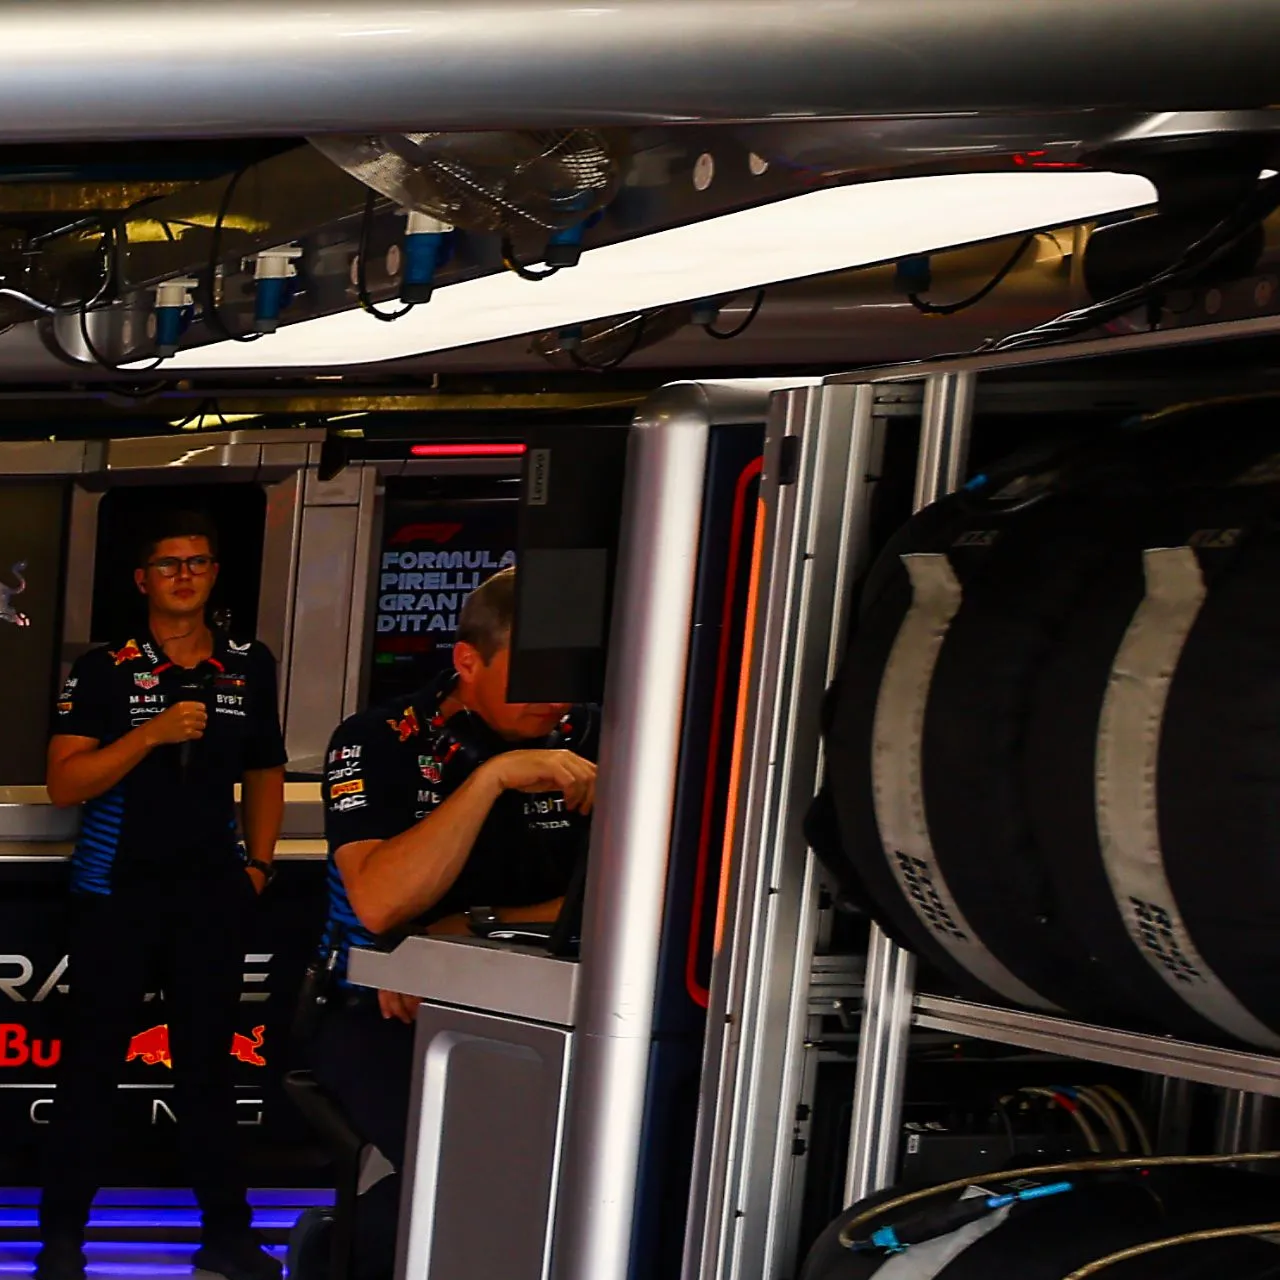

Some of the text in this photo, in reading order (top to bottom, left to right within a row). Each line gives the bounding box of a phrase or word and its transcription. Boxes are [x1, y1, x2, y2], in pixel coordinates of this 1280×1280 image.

[381, 550, 517, 569] FORMULA
[380, 571, 481, 591] PIRELLI
[378, 593, 458, 612] GRAN
[375, 613, 460, 633] D'ITAL
